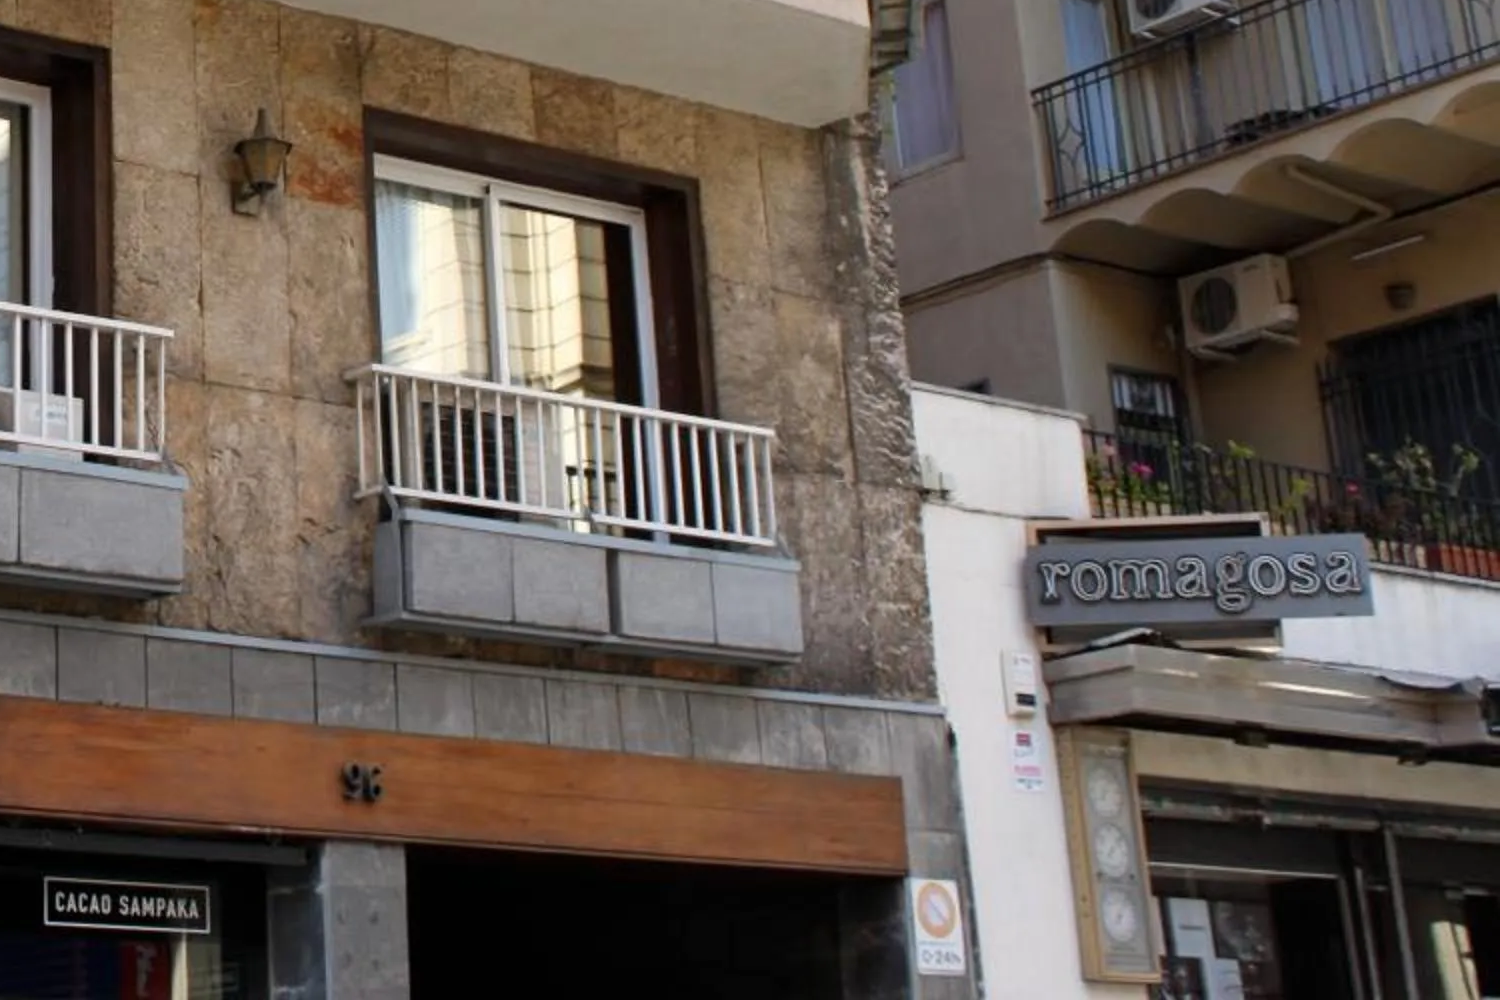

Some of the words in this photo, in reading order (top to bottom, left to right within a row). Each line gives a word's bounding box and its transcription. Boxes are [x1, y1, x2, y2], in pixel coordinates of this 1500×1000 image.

[1040, 549, 1363, 614] romagosa
[55, 891, 112, 915] CACAO
[118, 895, 200, 919] SAMPAKA
